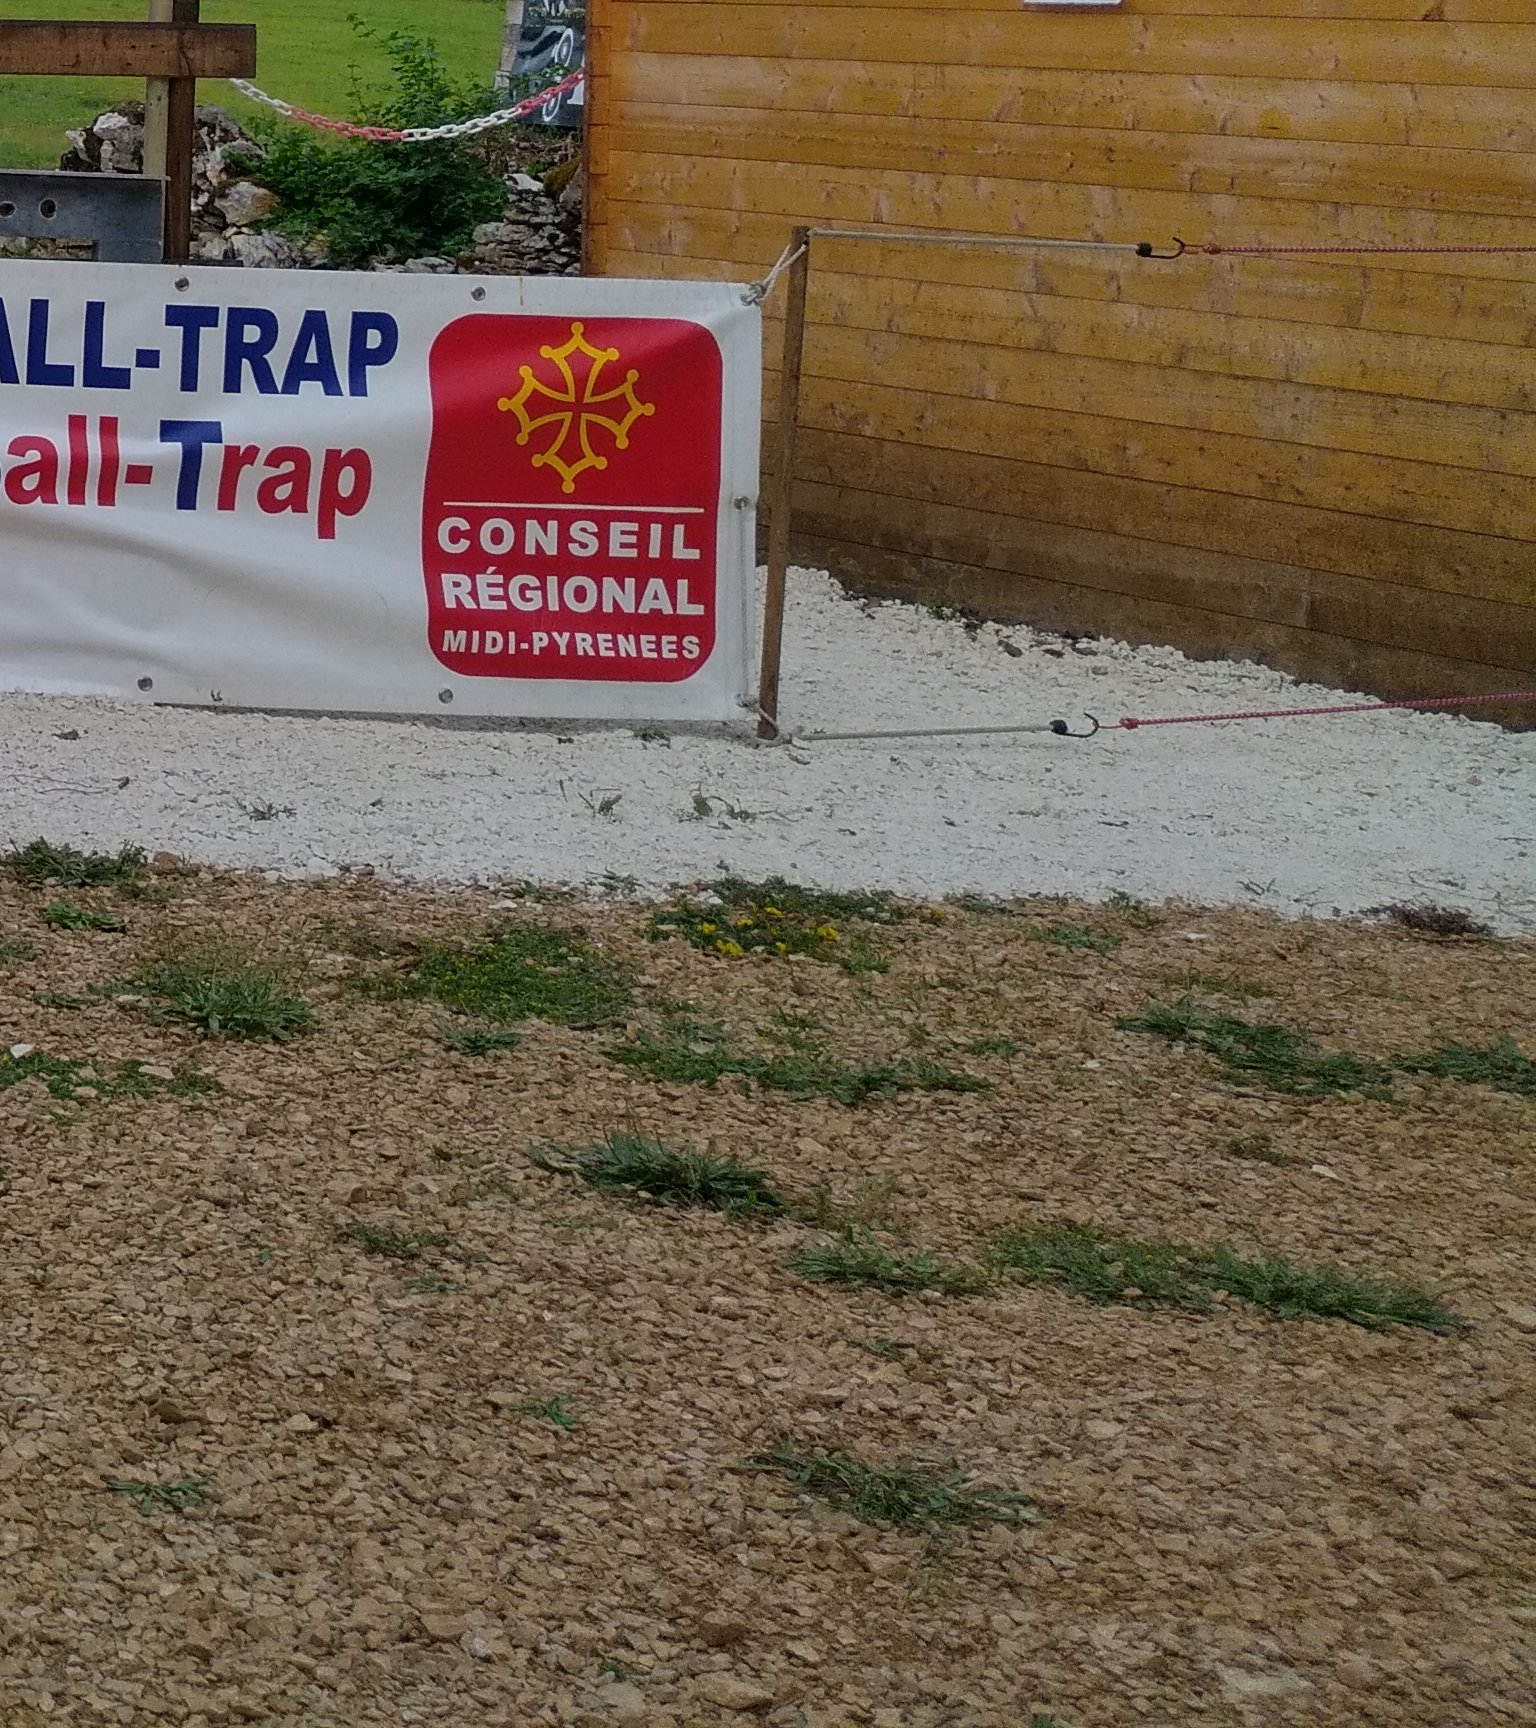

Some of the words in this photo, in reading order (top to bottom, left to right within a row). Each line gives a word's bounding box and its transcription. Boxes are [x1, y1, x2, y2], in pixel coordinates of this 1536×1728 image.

[437, 517, 701, 560] CONSEIL
[440, 567, 705, 616] RÉGIONAL
[441, 630, 701, 660] MIDI-PYRENEES
